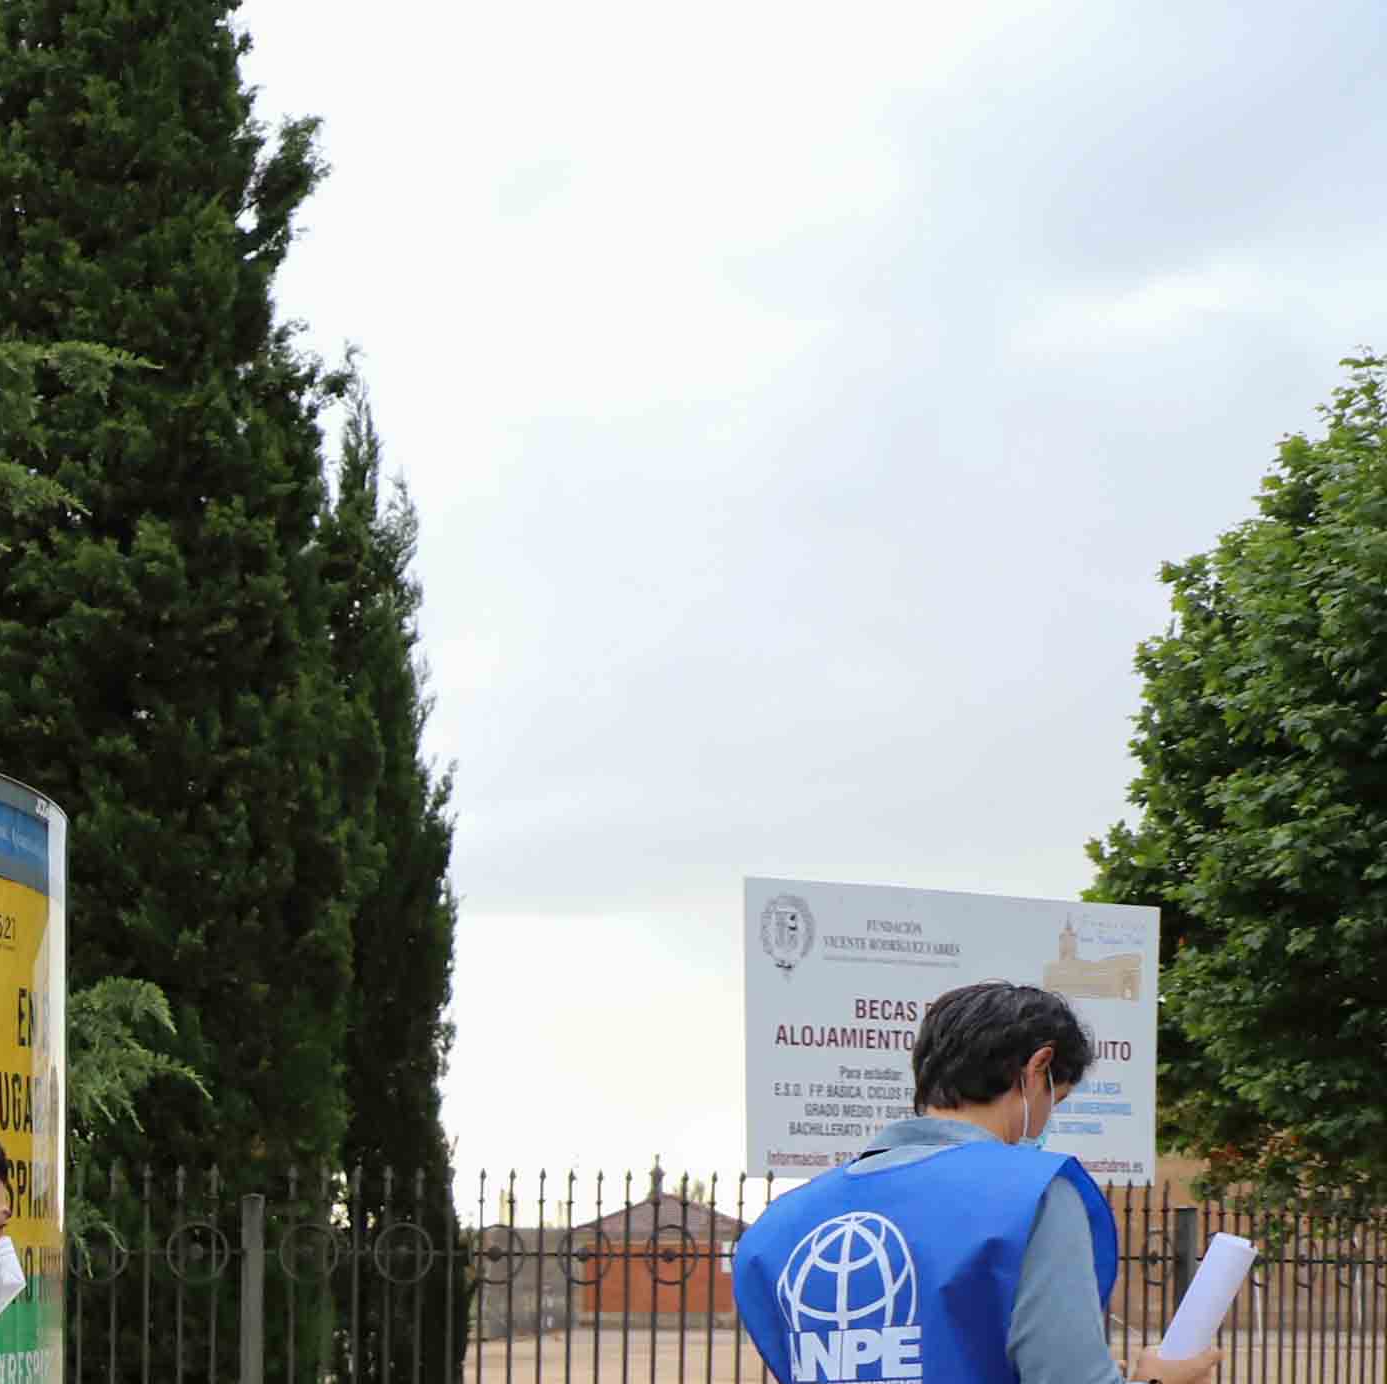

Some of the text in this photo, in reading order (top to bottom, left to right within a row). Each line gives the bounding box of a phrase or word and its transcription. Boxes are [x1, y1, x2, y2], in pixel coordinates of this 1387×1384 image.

[855, 999, 917, 1021] BECAS
[775, 1024, 916, 1051] ALOJAMIENTO
[804, 1103, 840, 1117] GRADO
[842, 1104, 873, 1118] MEDIO
[876, 1106, 884, 1118] Y
[789, 1121, 862, 1136] BACHILLERATO
